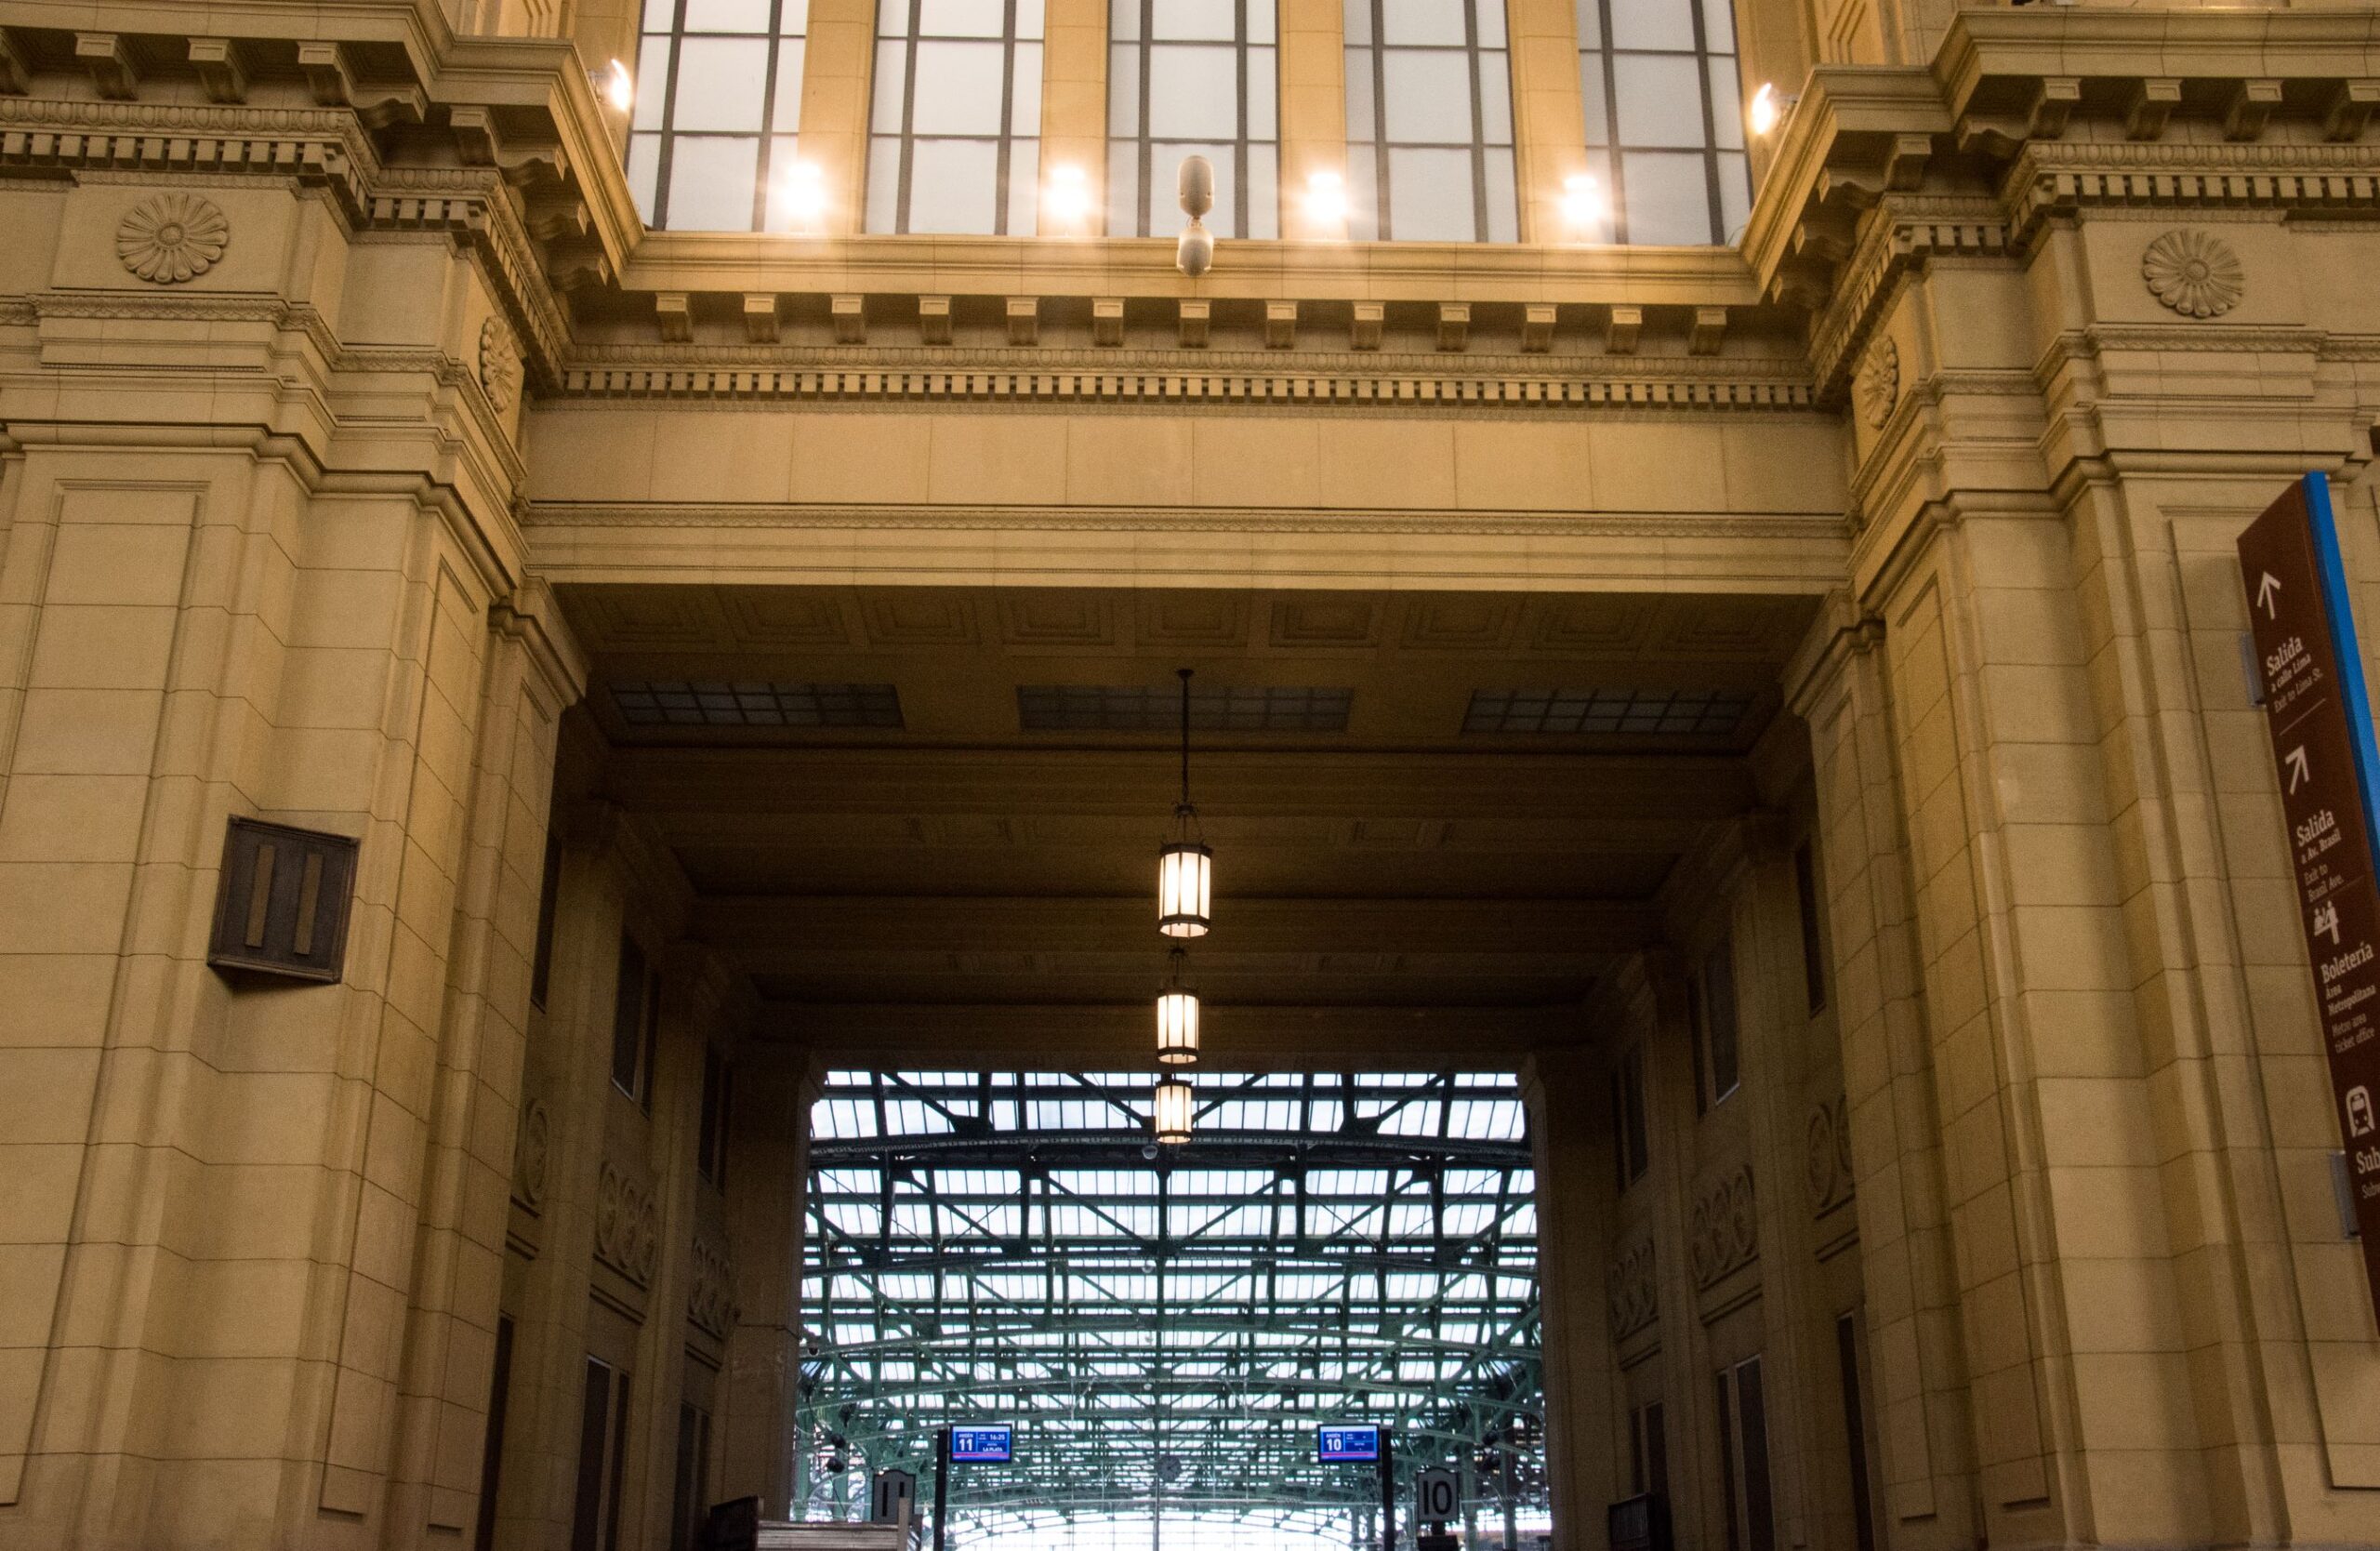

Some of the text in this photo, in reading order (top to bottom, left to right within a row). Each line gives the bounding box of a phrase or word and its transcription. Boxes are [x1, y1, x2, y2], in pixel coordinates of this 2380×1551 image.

[2266, 636, 2304, 677] Salida
[2292, 653, 2312, 674] Lima
[2296, 809, 2335, 847] Salida
[2319, 828, 2342, 852] Brasil
[2320, 941, 2374, 984] Boletería
[2328, 985, 2376, 1016] Metropolitana
[959, 1438, 972, 1452] 11
[1327, 1438, 1342, 1452] 10
[1422, 1479, 1452, 1516] 10
